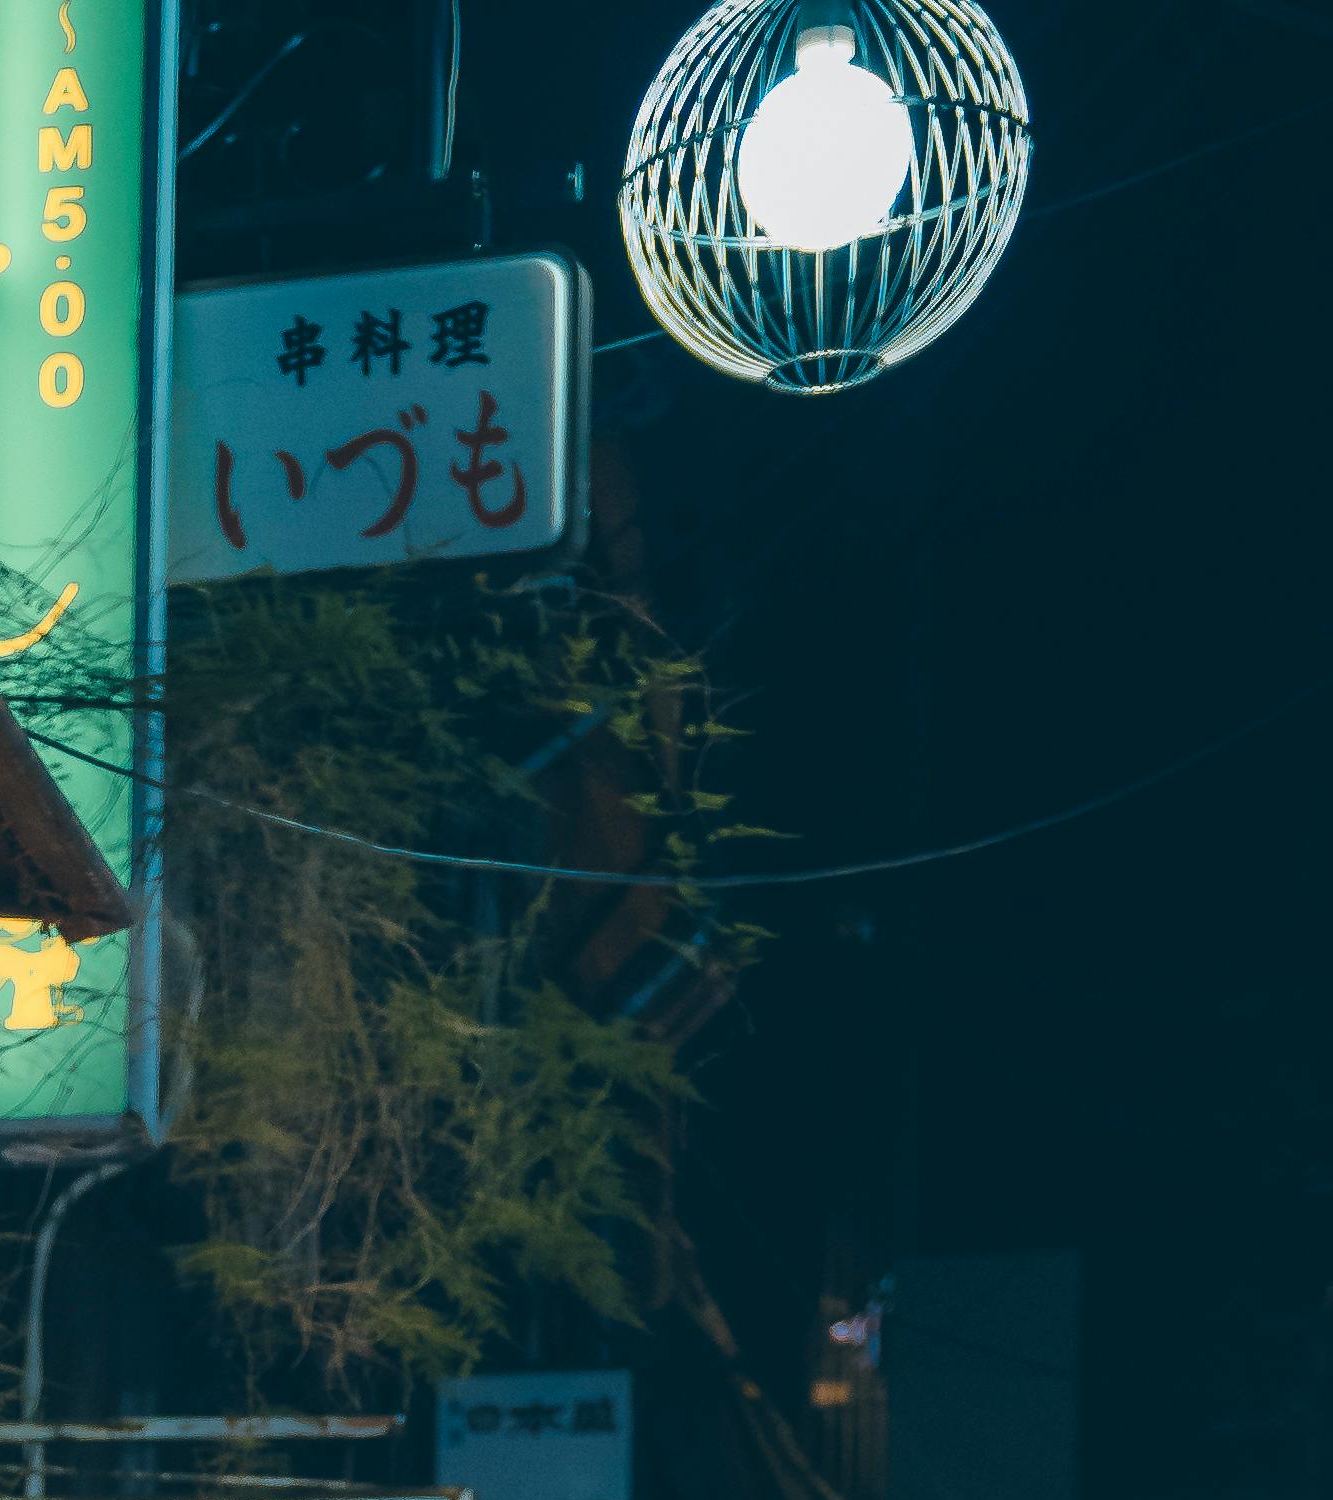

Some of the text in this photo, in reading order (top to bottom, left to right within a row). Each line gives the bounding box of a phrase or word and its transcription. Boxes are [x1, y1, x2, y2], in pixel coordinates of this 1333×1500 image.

[277, 299, 491, 388] 串料理
[213, 388, 528, 550] いづも
